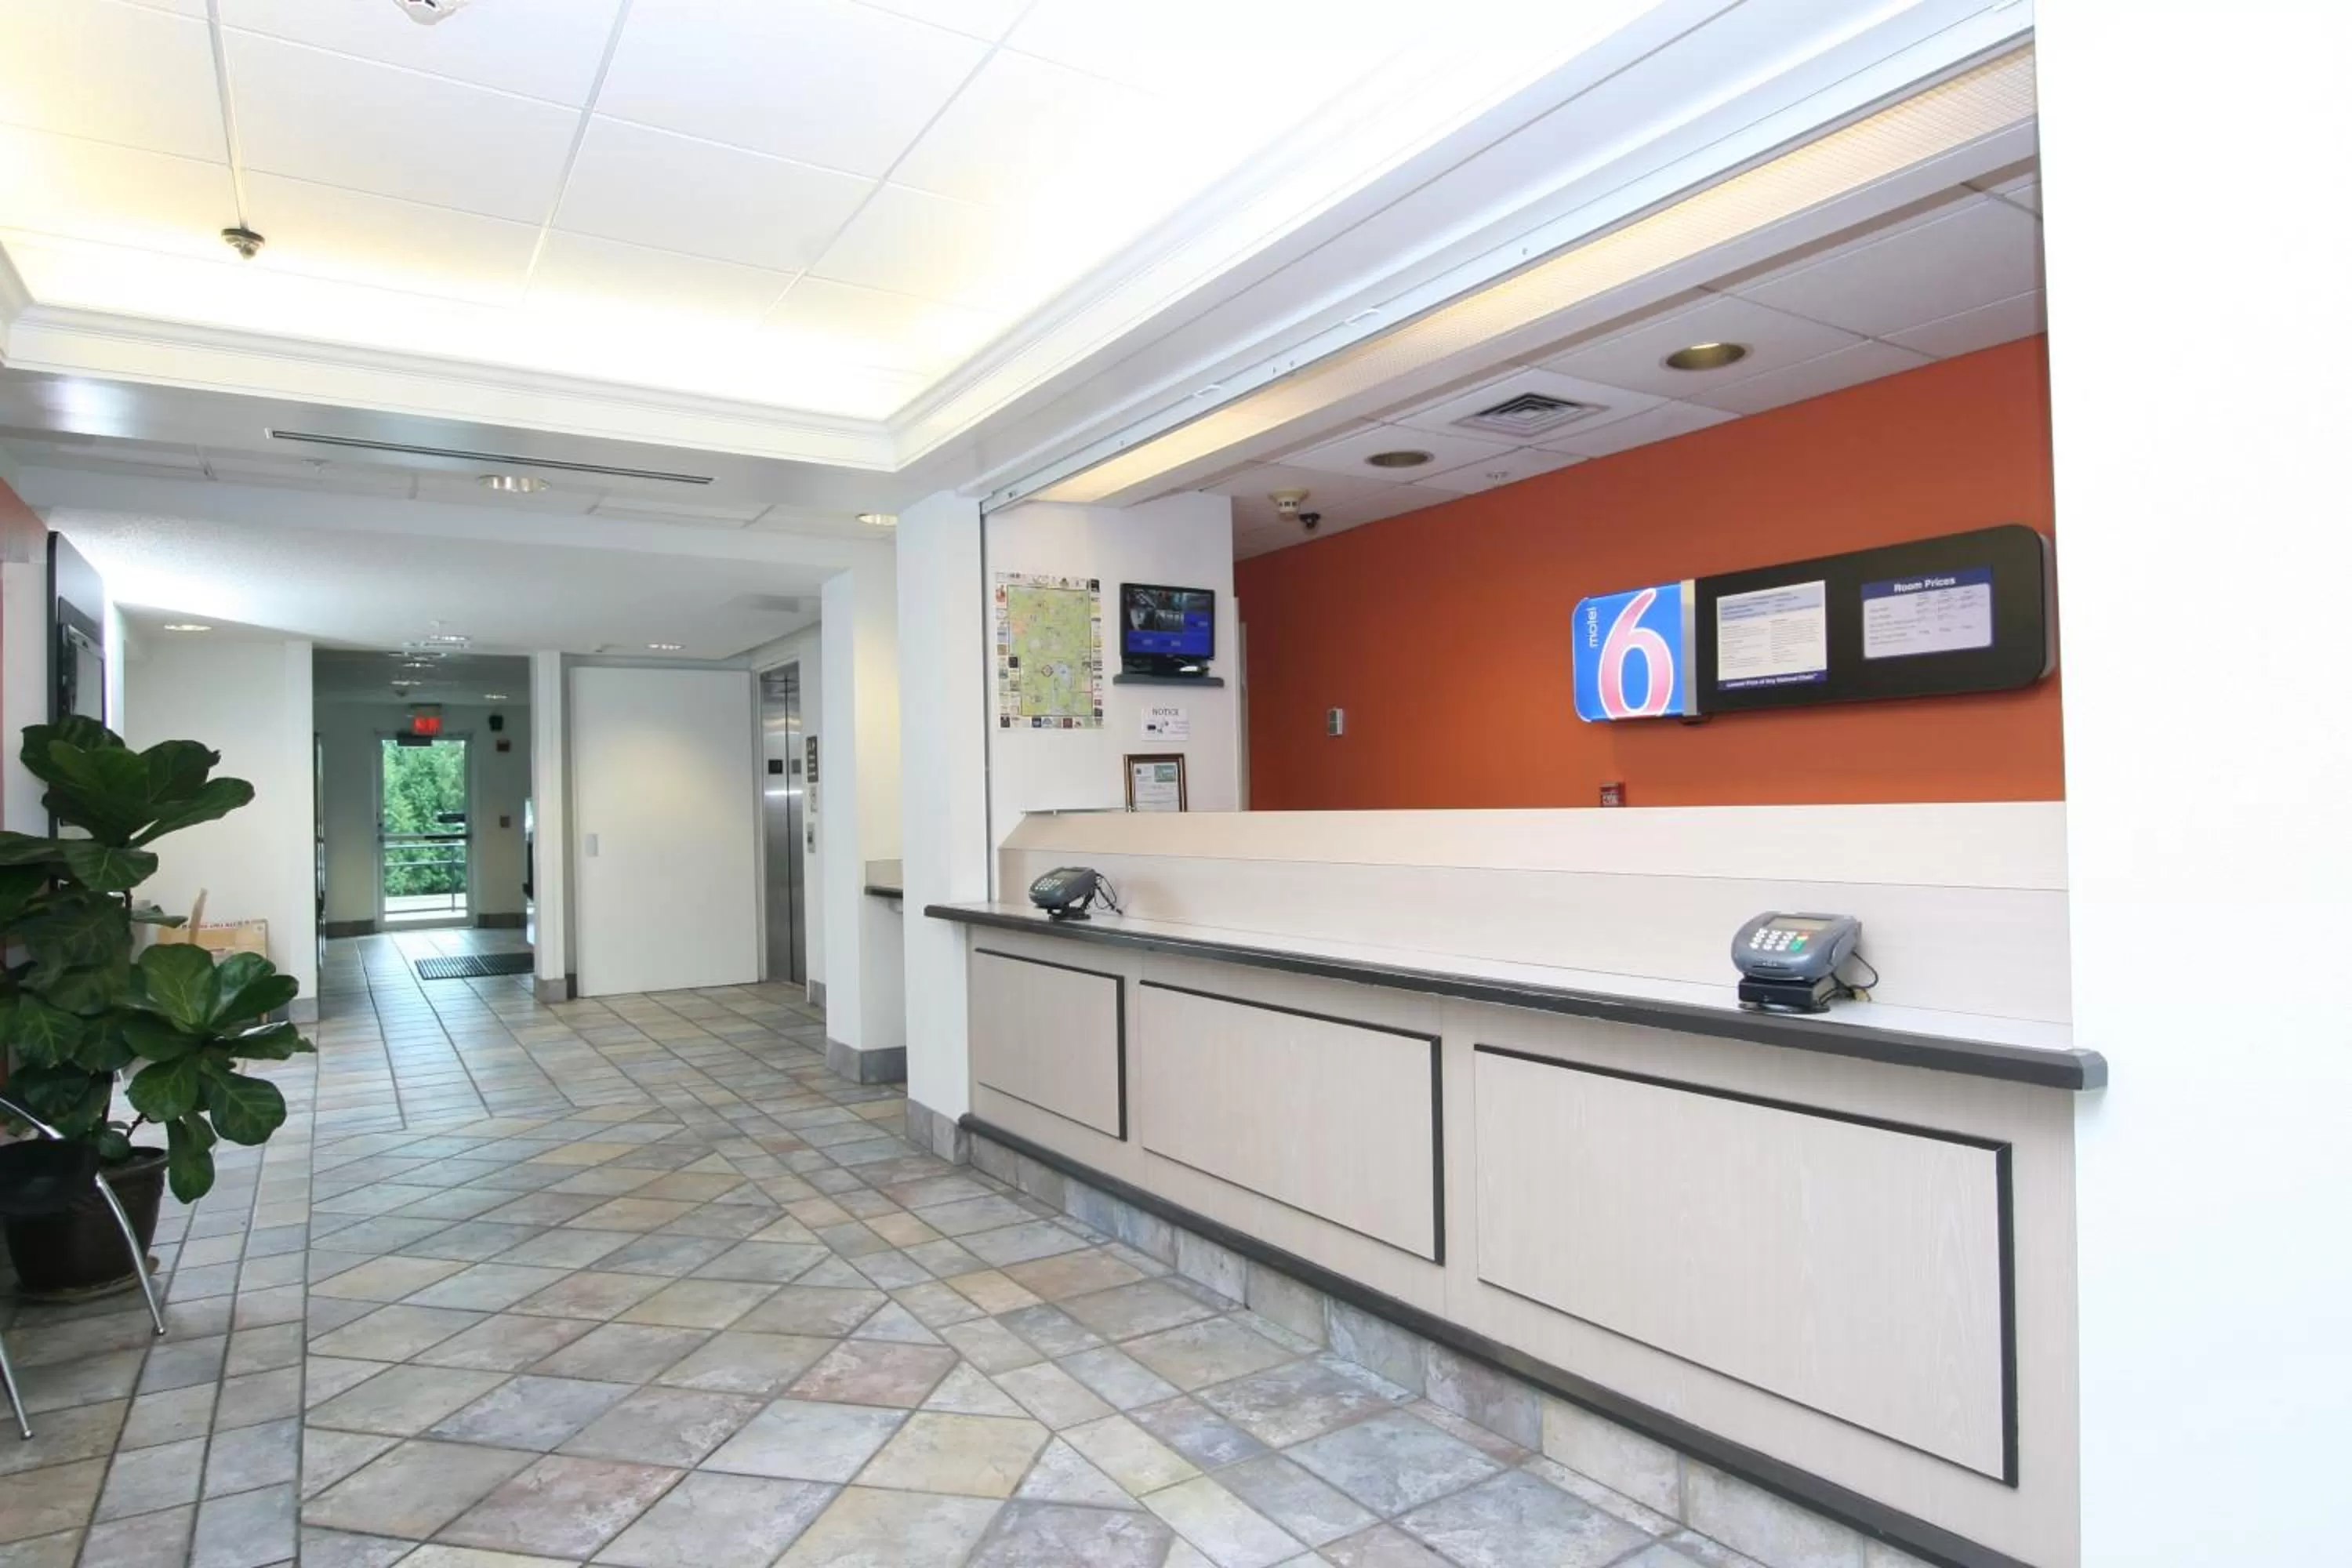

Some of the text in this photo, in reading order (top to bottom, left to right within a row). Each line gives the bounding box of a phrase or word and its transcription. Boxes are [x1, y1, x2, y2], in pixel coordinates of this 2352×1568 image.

[1893, 577, 1956, 593] Room Prices
[1586, 606, 1599, 648] motel
[1598, 587, 1674, 720] 6
[1152, 707, 1180, 716] NOTICE
